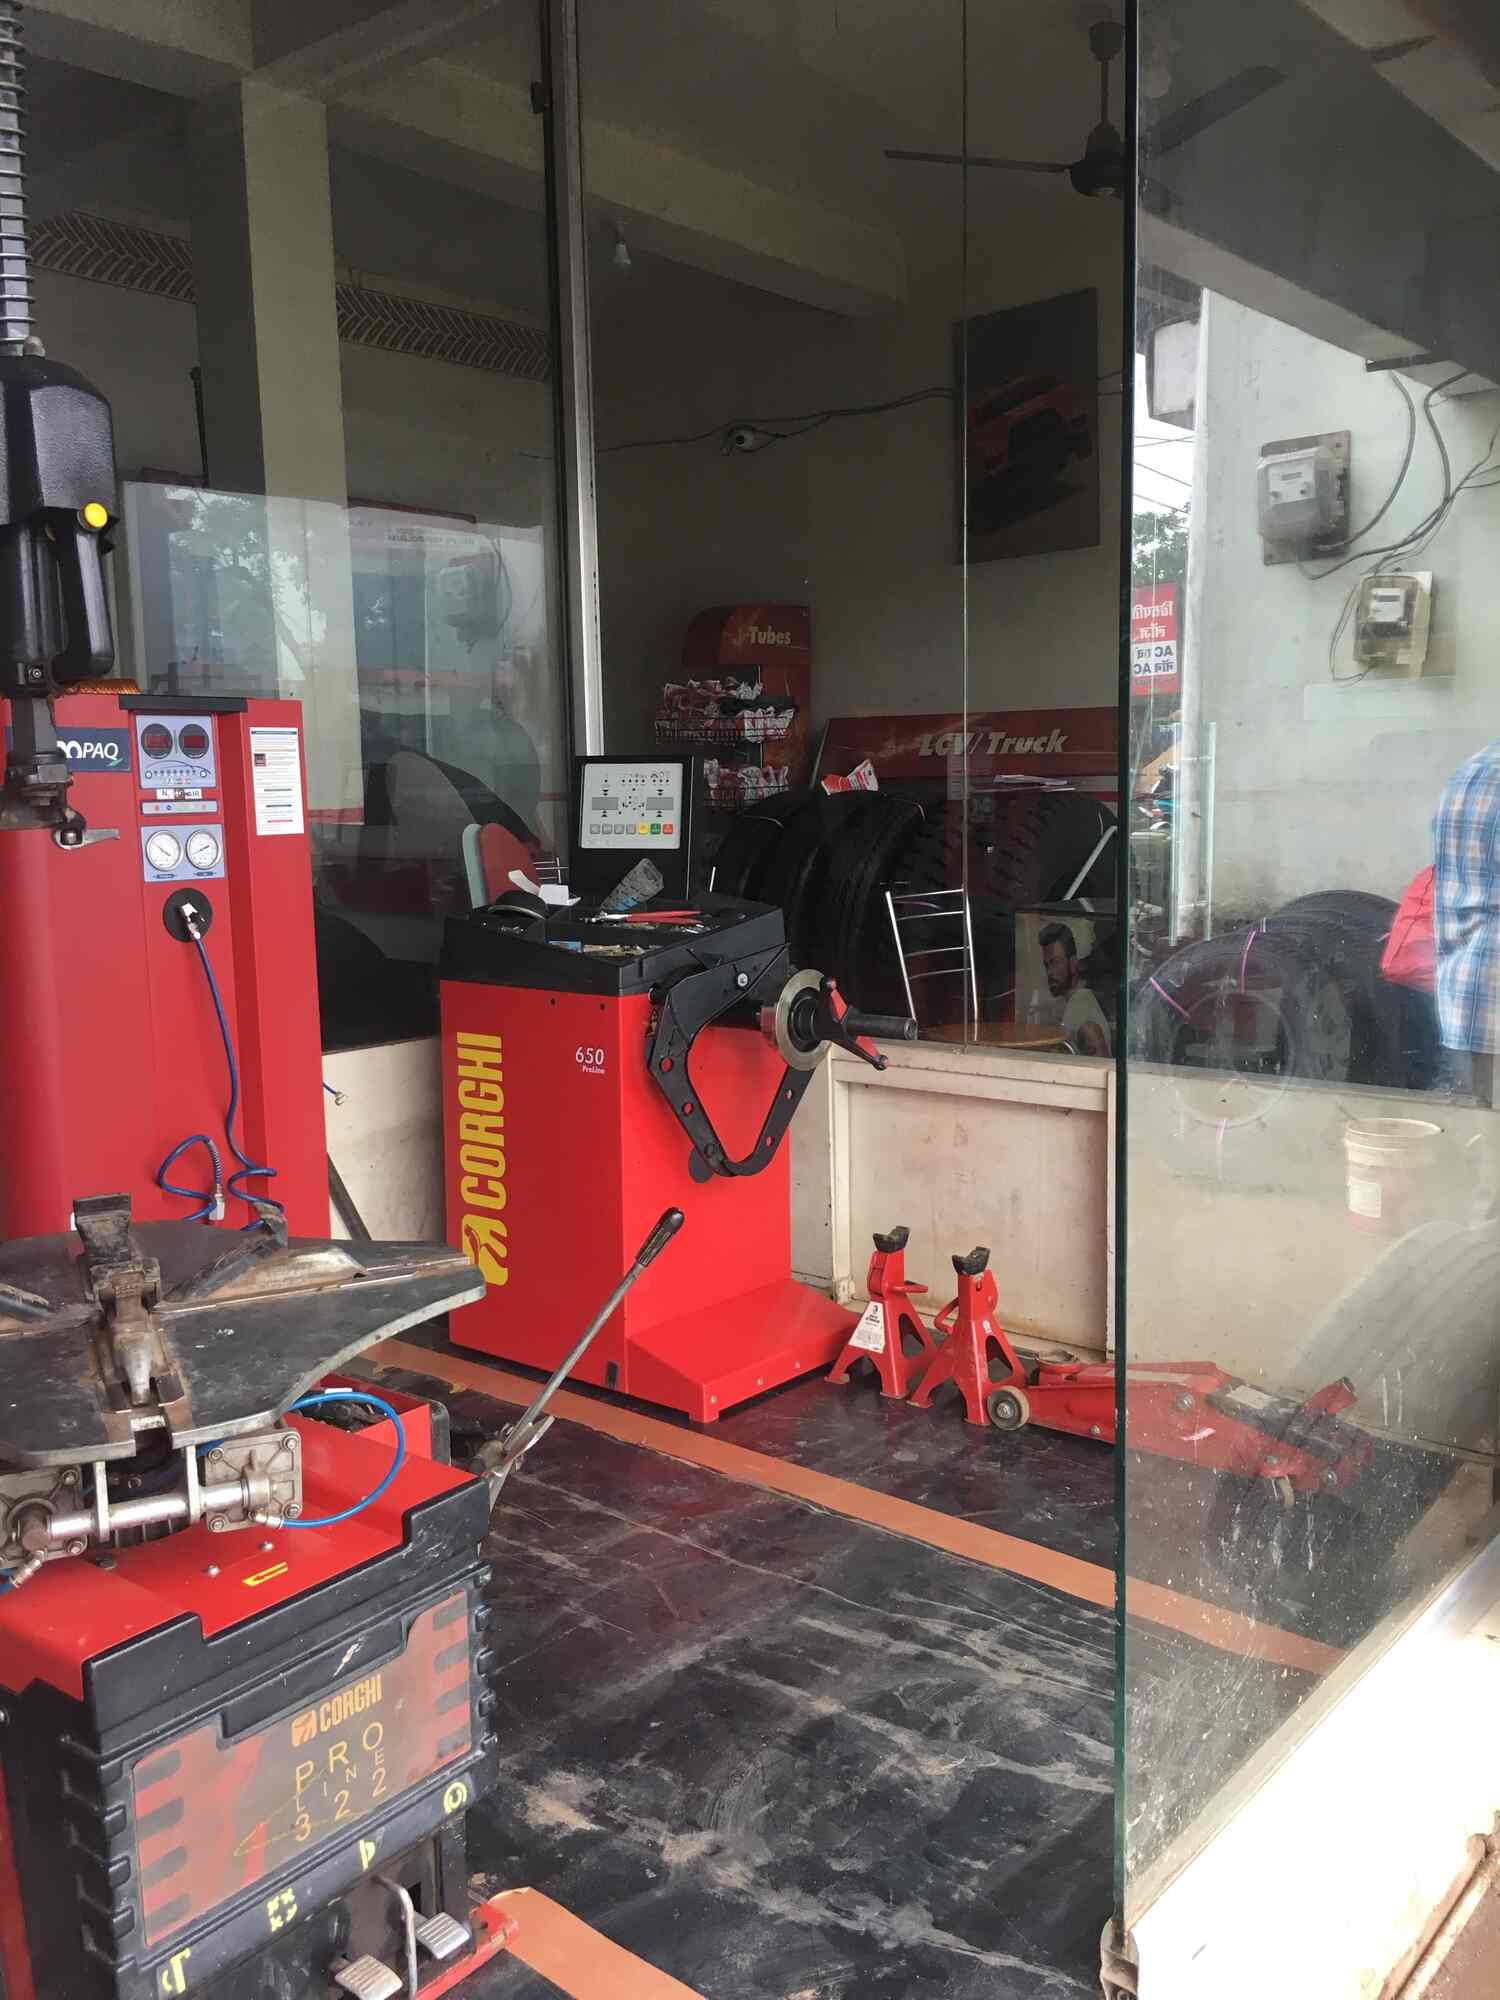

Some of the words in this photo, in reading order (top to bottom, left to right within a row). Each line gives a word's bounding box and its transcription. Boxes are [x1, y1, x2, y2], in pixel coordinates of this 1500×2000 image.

[575, 1046, 604, 1065] 650
[456, 1031, 507, 1211] CORGHI
[319, 1673, 383, 1733] CORGHI
[295, 1721, 384, 1793] PRO
[294, 1767, 387, 1842] 322
